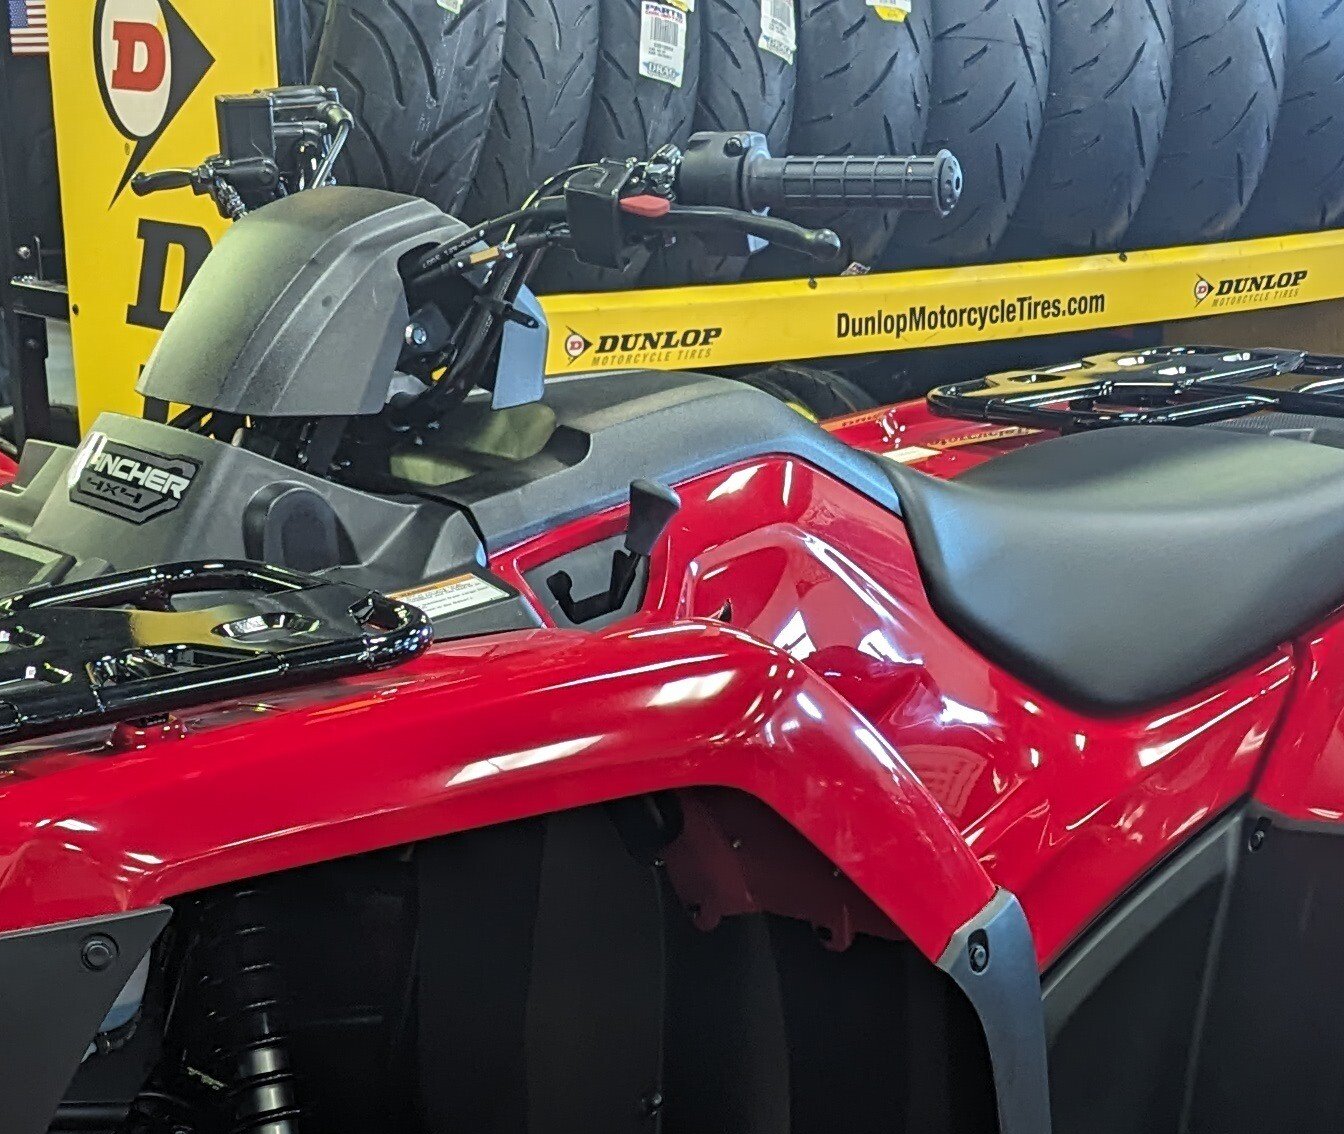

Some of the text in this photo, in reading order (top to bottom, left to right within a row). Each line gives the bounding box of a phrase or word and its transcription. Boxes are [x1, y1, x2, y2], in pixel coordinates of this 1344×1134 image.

[111, 20, 167, 92] D
[1216, 269, 1308, 297] DUNLOP
[1211, 288, 1300, 308] MOTORCYCLE TIRES
[836, 293, 1106, 340] DunlopMotorcycleTires.com
[594, 327, 723, 354] DUNLOP
[590, 348, 712, 367] MOTORCYCLE TIRES
[78, 449, 191, 500] ANCHER
